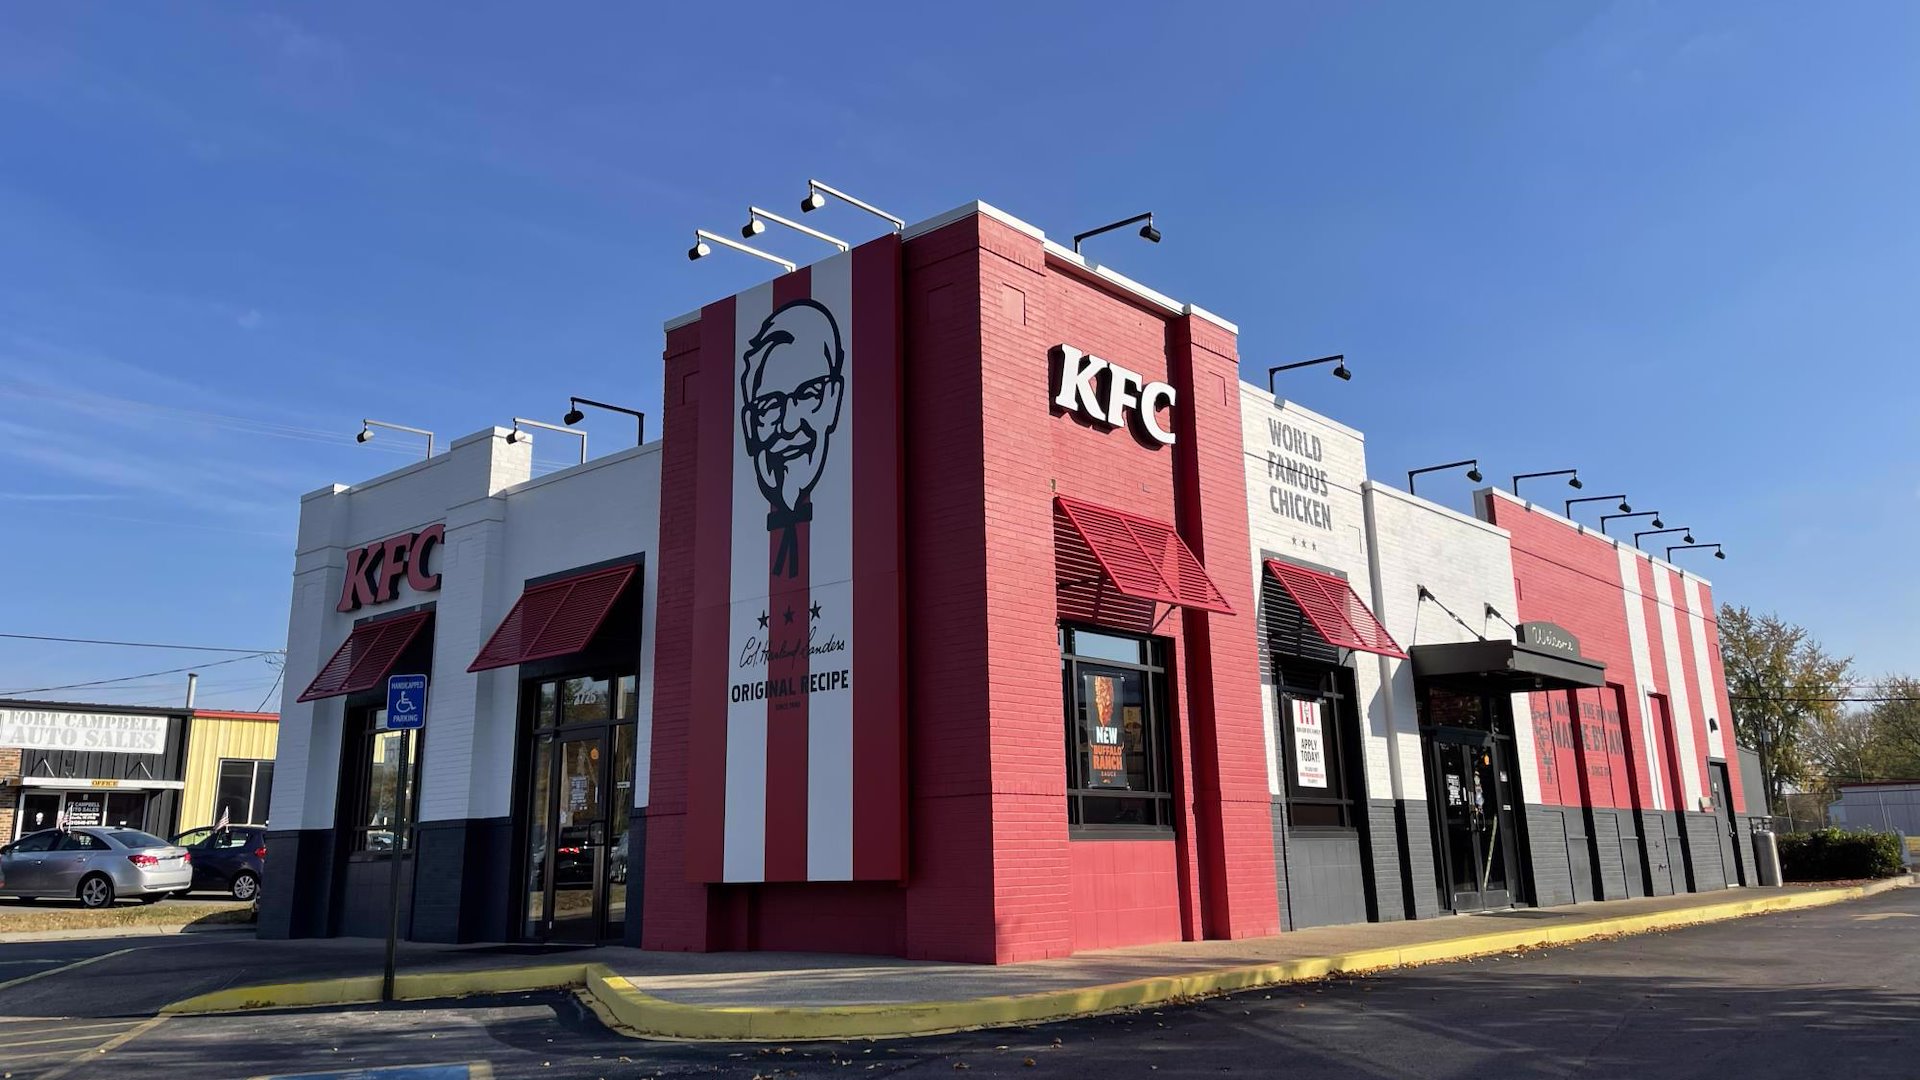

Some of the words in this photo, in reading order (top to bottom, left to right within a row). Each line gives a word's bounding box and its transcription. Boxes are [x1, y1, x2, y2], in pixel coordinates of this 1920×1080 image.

[1050, 343, 1176, 447] KFC
[1268, 417, 1322, 463] WORLD
[1267, 450, 1329, 498] FAMOUS
[1269, 486, 1332, 531] CHICKEN
[337, 524, 445, 612] KFC
[800, 626, 845, 659] Sanders
[1532, 626, 1573, 651] Welcome
[391, 681, 424, 689] HANDICAPPED
[731, 677, 797, 702] ORIGINAL
[800, 669, 849, 693] RECIPE
[8, 710, 59, 727] FORT
[64, 714, 161, 731] CAMPBELL
[393, 714, 418, 722] PARKING
[8, 726, 77, 745] AUTO
[84, 729, 156, 749] SALES
[1095, 725, 1118, 744] NEW
[1301, 738, 1317, 751] APPLY
[1093, 744, 1122, 756] BUFFALO
[1301, 750, 1320, 763] TODAY!
[1093, 755, 1123, 770] RANCH
